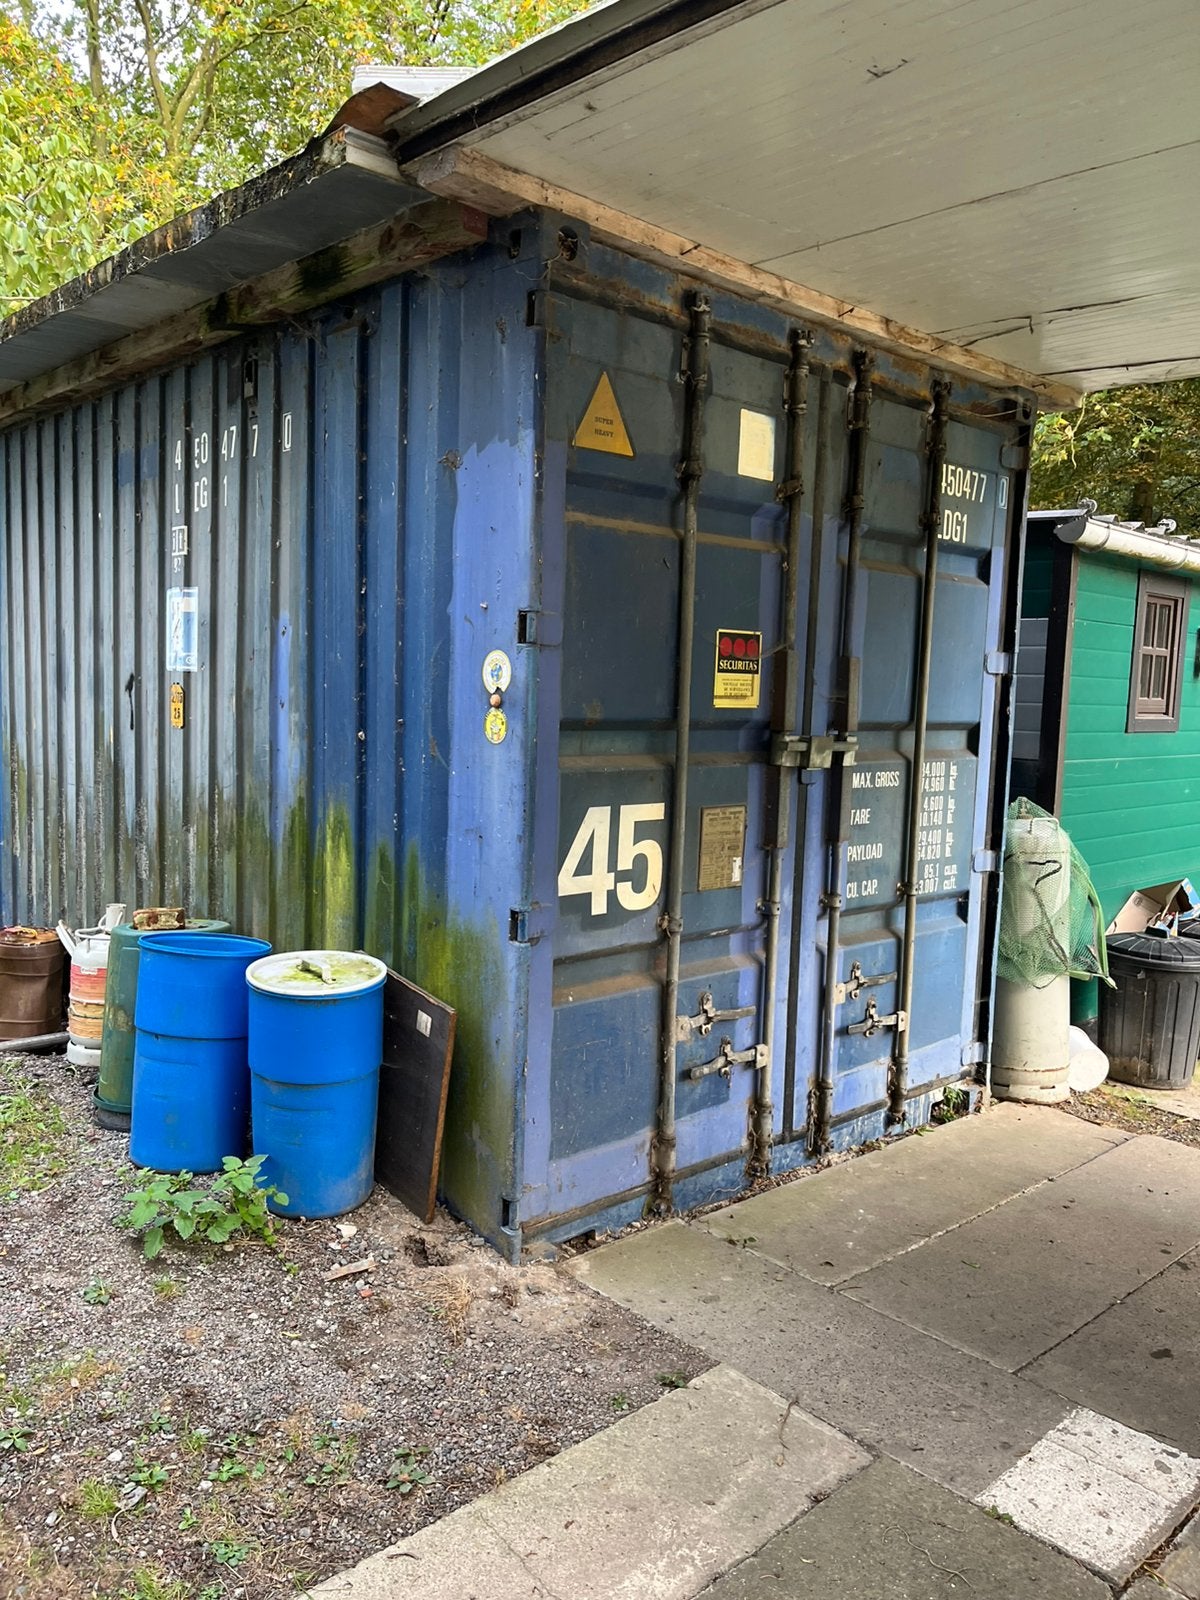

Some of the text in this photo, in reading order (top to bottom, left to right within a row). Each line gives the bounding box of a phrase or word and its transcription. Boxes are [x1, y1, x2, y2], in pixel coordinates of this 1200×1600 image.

[937, 509, 968, 543] DG1
[719, 660, 758, 671] SECURITAS
[852, 772, 873, 789] MAX.
[875, 771, 900, 788] GROSS
[850, 808, 871, 826] TARE
[557, 802, 665, 916] 45
[847, 843, 883, 862] PAYLOAD
[846, 881, 859, 899] CU.
[861, 879, 878, 897] CAP.
[924, 863, 940, 879] 85.1
